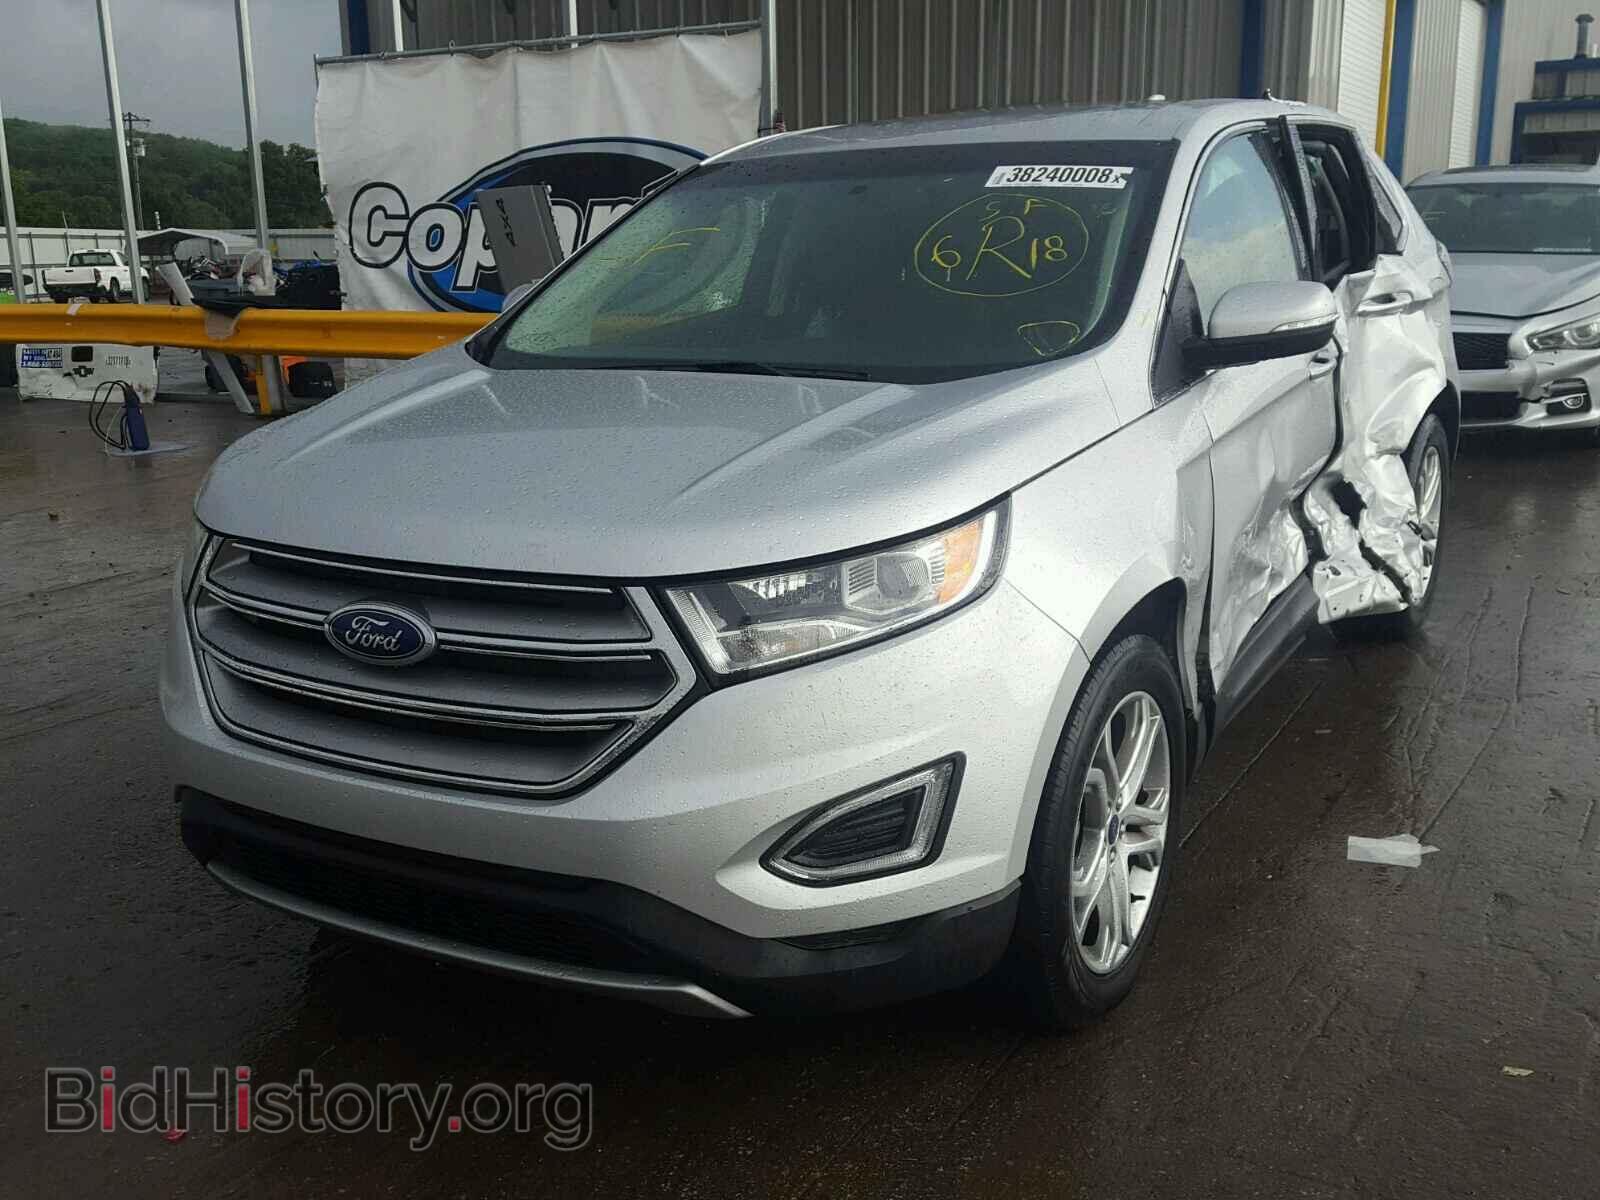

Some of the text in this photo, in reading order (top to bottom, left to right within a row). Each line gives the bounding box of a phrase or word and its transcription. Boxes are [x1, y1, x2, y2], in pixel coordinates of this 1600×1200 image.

[1006, 166, 1113, 183] 38240008
[965, 215, 1032, 281] R
[345, 615, 403, 652] Ford
